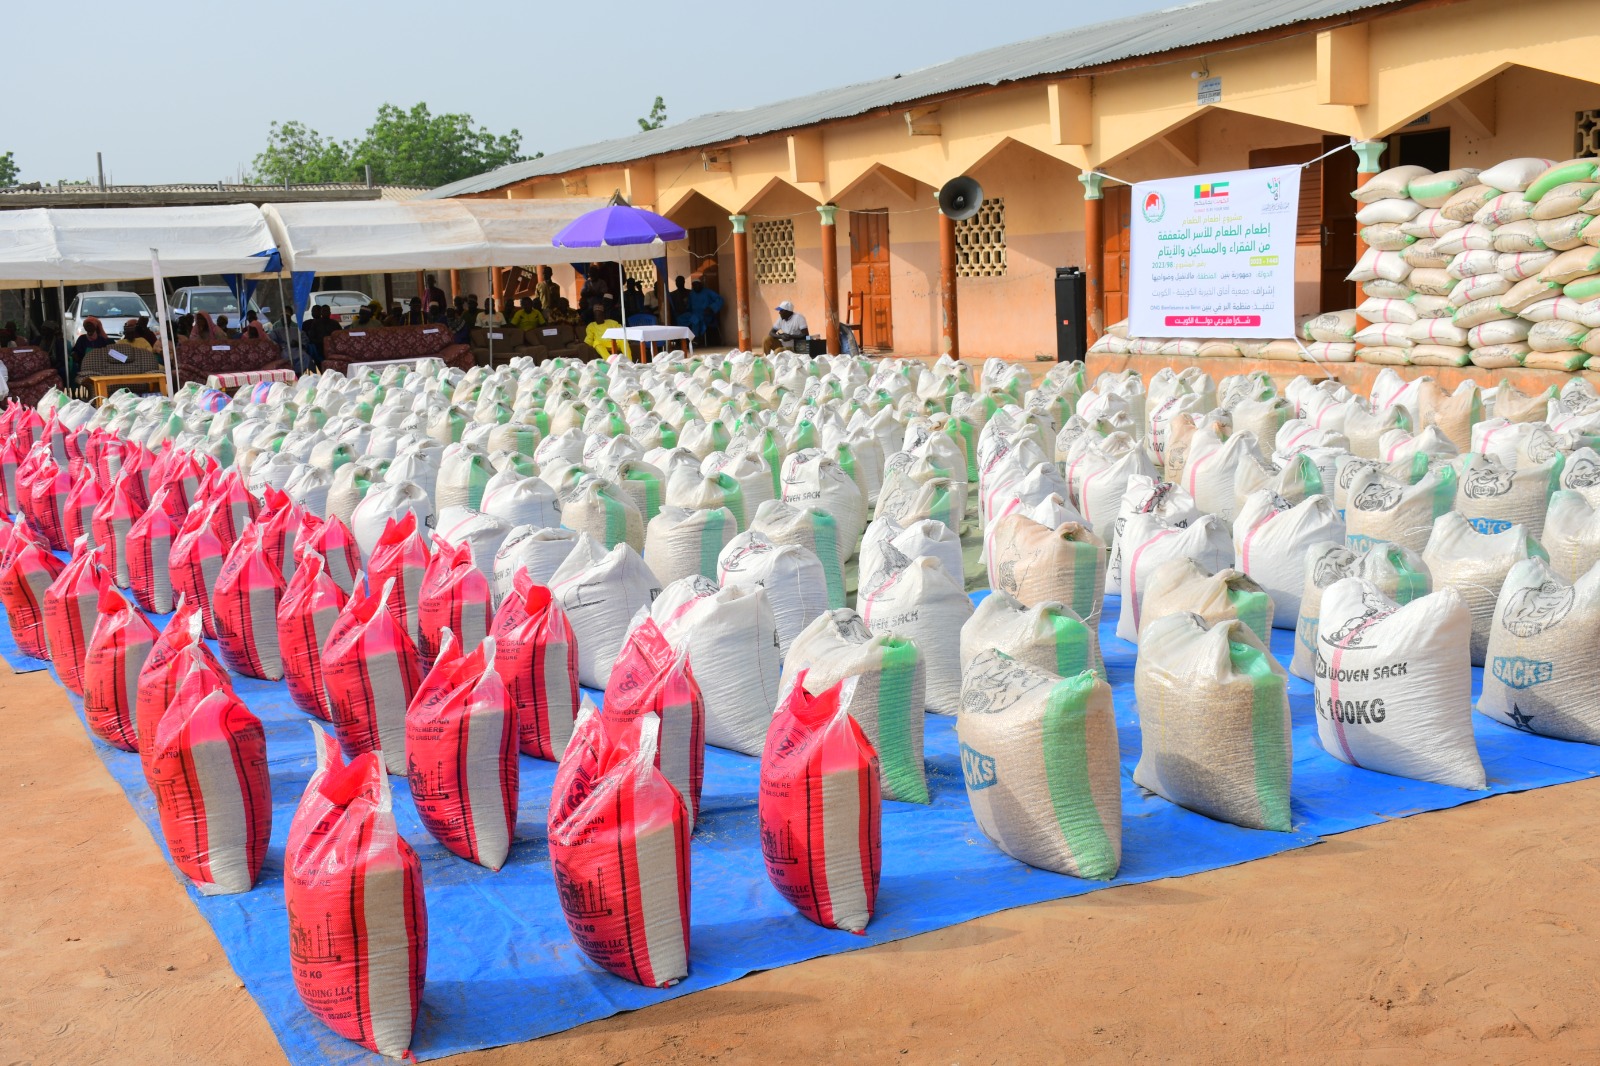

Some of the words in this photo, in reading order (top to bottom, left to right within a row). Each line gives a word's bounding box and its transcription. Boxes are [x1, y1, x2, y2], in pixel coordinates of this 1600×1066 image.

[1158, 228, 1191, 241] المتعففة
[1192, 226, 1213, 241] للأسر
[1215, 224, 1242, 240] الطعام
[1244, 222, 1271, 238] إطعام
[1157, 244, 1186, 260] والأيتام
[1187, 242, 1227, 258] والمساكين
[1229, 240, 1256, 254] الفقراء
[1258, 242, 1271, 254] من
[1231, 271, 1252, 279] جمهورية
[1174, 316, 1195, 326] الكويت
[803, 491, 821, 500] SACK
[891, 609, 919, 627] SACK
[1328, 666, 1370, 683] WOVEN
[1373, 662, 1408, 681] SACK
[1494, 659, 1552, 687] SACKS
[1327, 697, 1386, 725] 100KG
[583, 924, 595, 933] KG
[608, 938, 625, 948] LLC
[299, 969, 308, 978] 25
[309, 970, 323, 979] KG
[299, 986, 333, 999] TRADING
[335, 985, 354, 997] LLC
